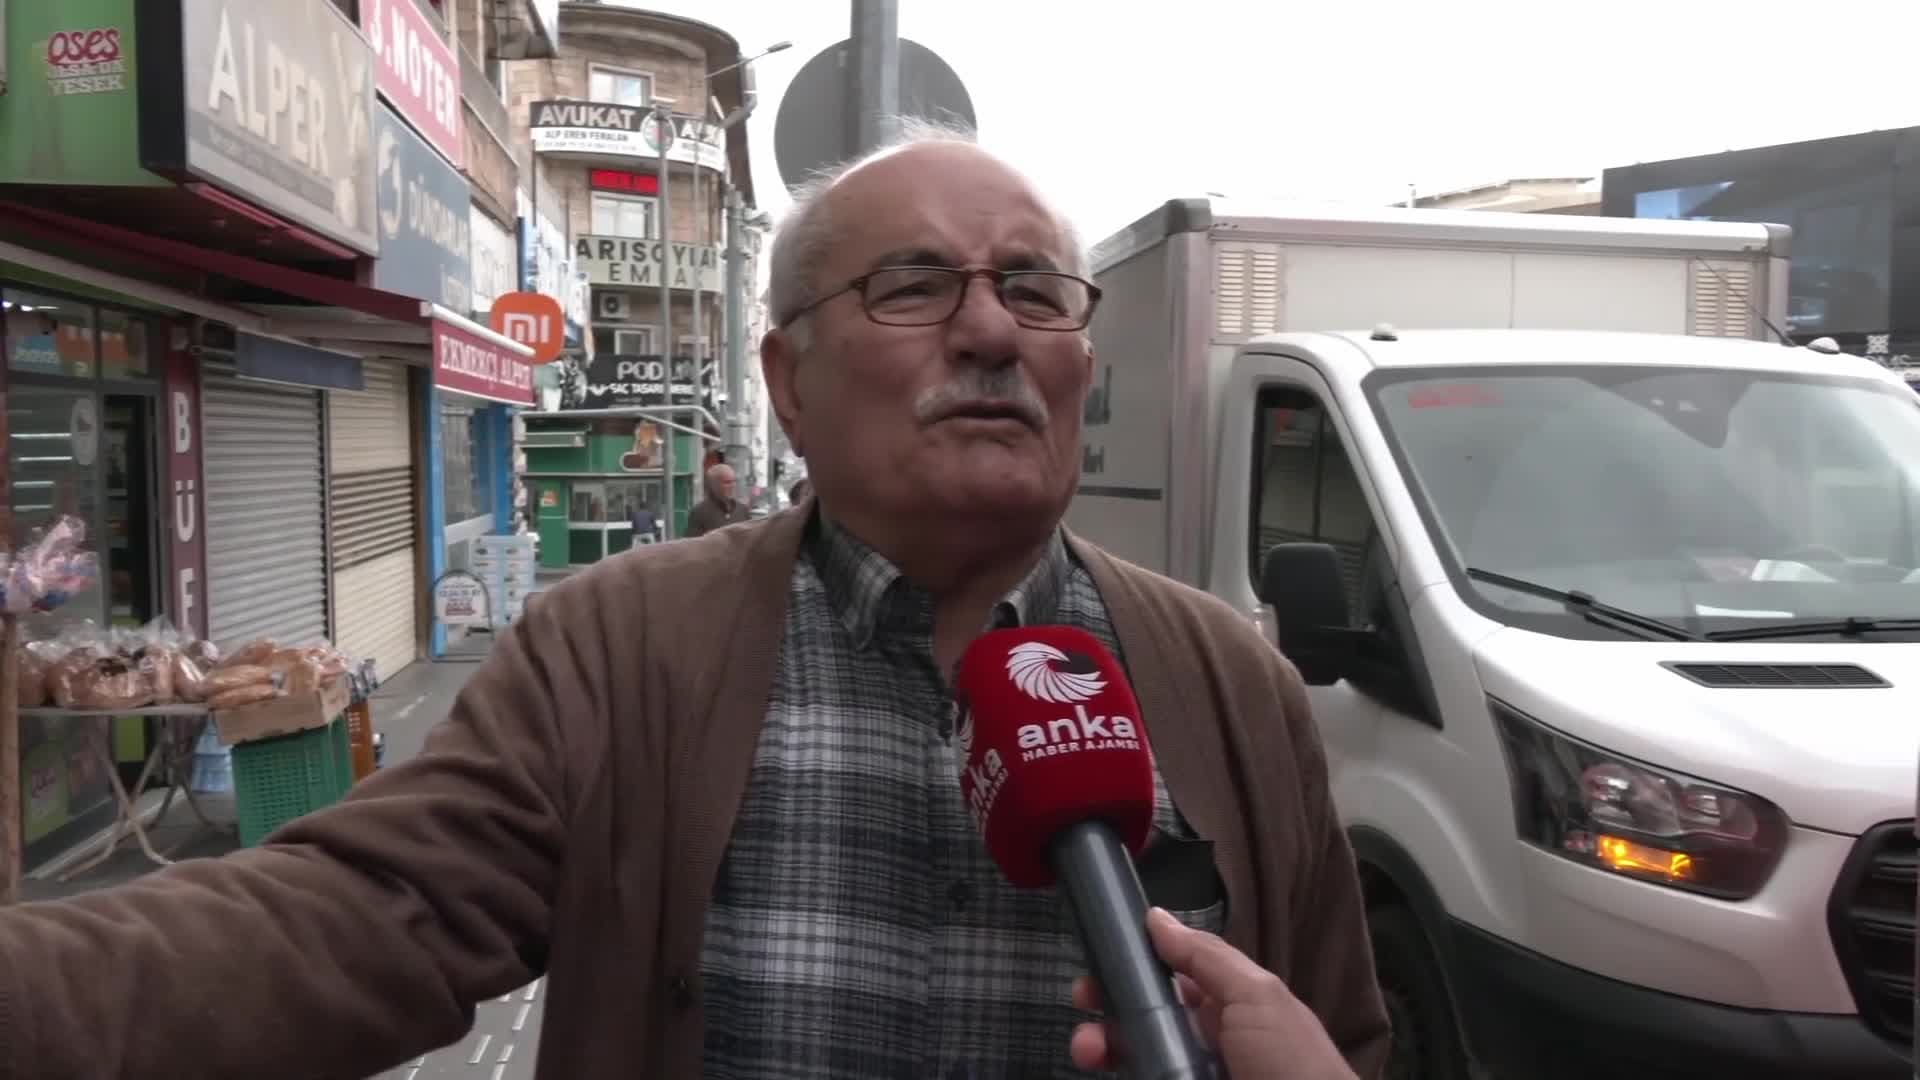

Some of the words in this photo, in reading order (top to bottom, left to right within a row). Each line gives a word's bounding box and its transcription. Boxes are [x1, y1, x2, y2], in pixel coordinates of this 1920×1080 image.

[208, 7, 330, 175] ALPER
[539, 104, 636, 130] AVUKAT
[1017, 704, 1138, 750] anka
[1020, 741, 1081, 763] HABER
[1084, 739, 1141, 751] AJANSI
